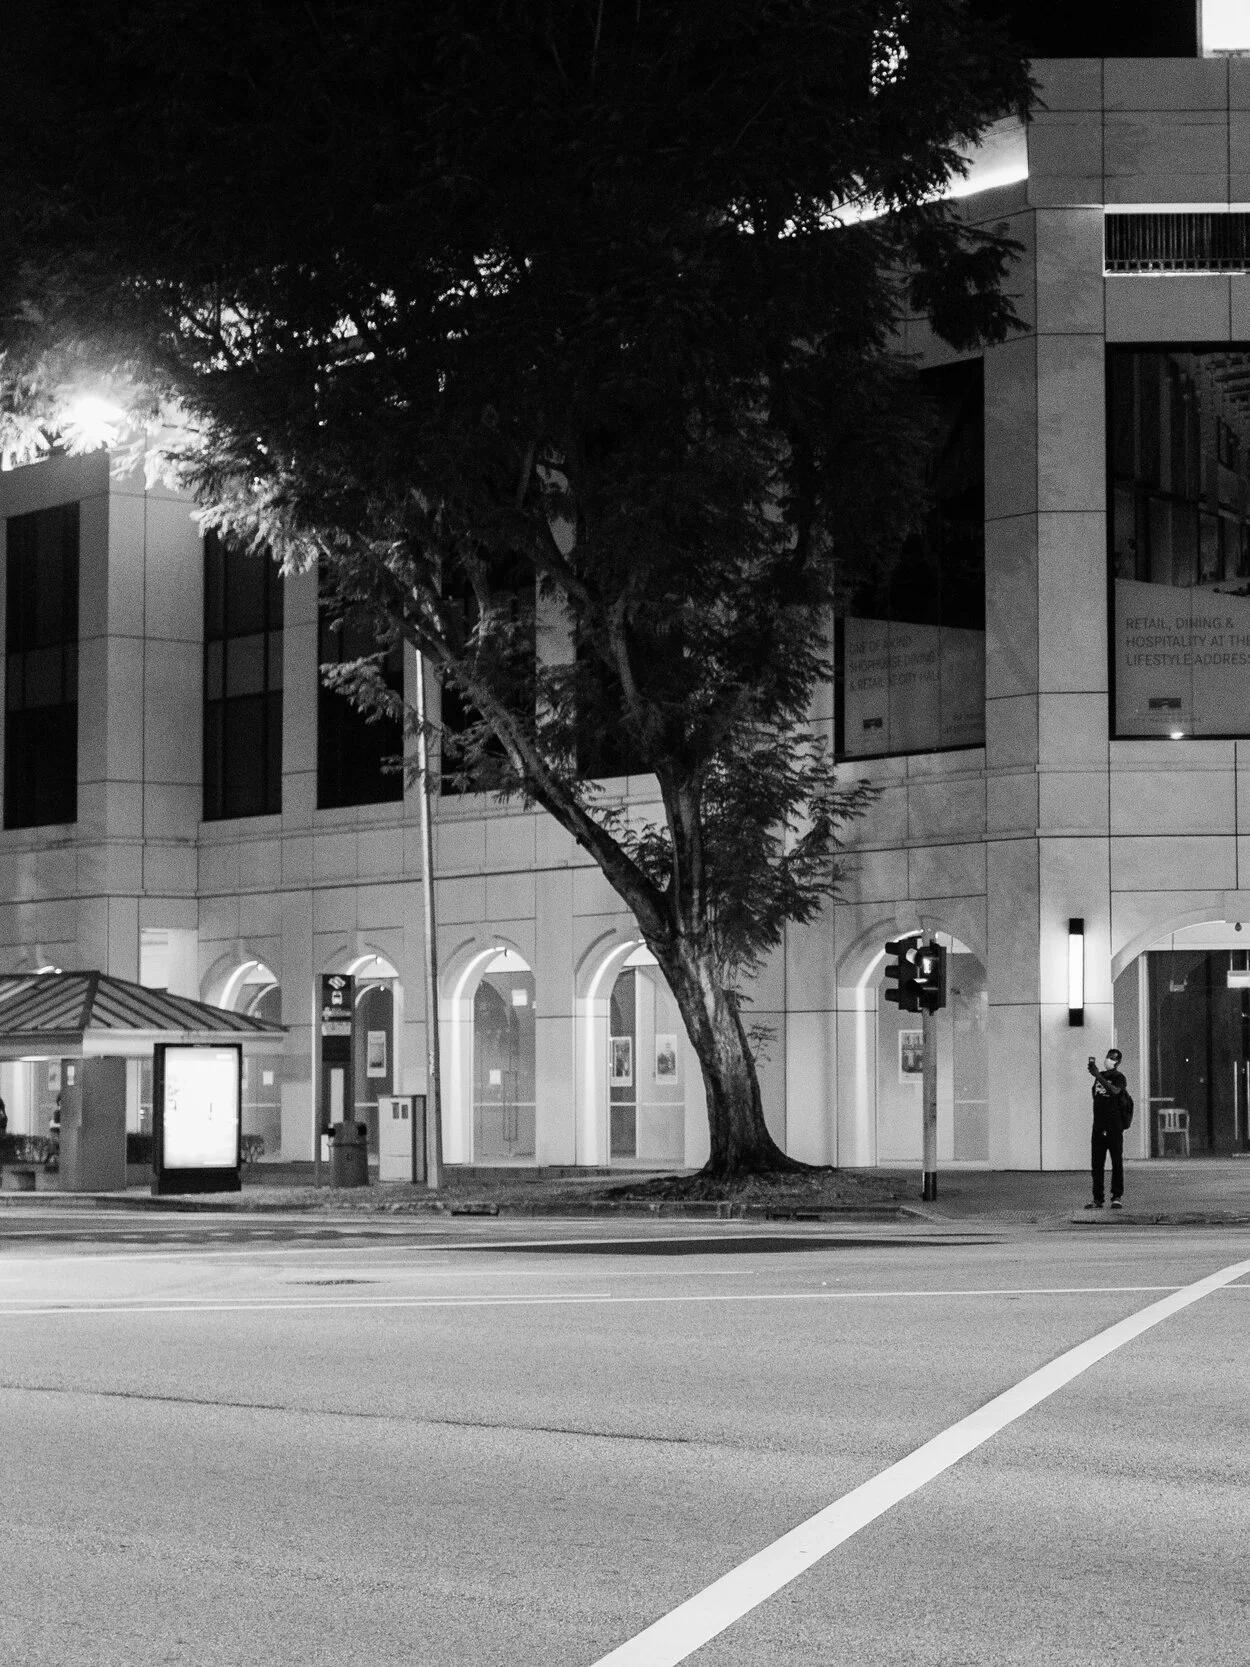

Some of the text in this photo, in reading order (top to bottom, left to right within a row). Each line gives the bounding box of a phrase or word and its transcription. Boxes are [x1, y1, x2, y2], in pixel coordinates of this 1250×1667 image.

[1126, 617, 1234, 631] RETAIL, DINING &
[1126, 635, 1206, 648] HOSPITALITY
[1210, 635, 1224, 647] AT
[1126, 653, 1192, 666] LIFESTYLE
